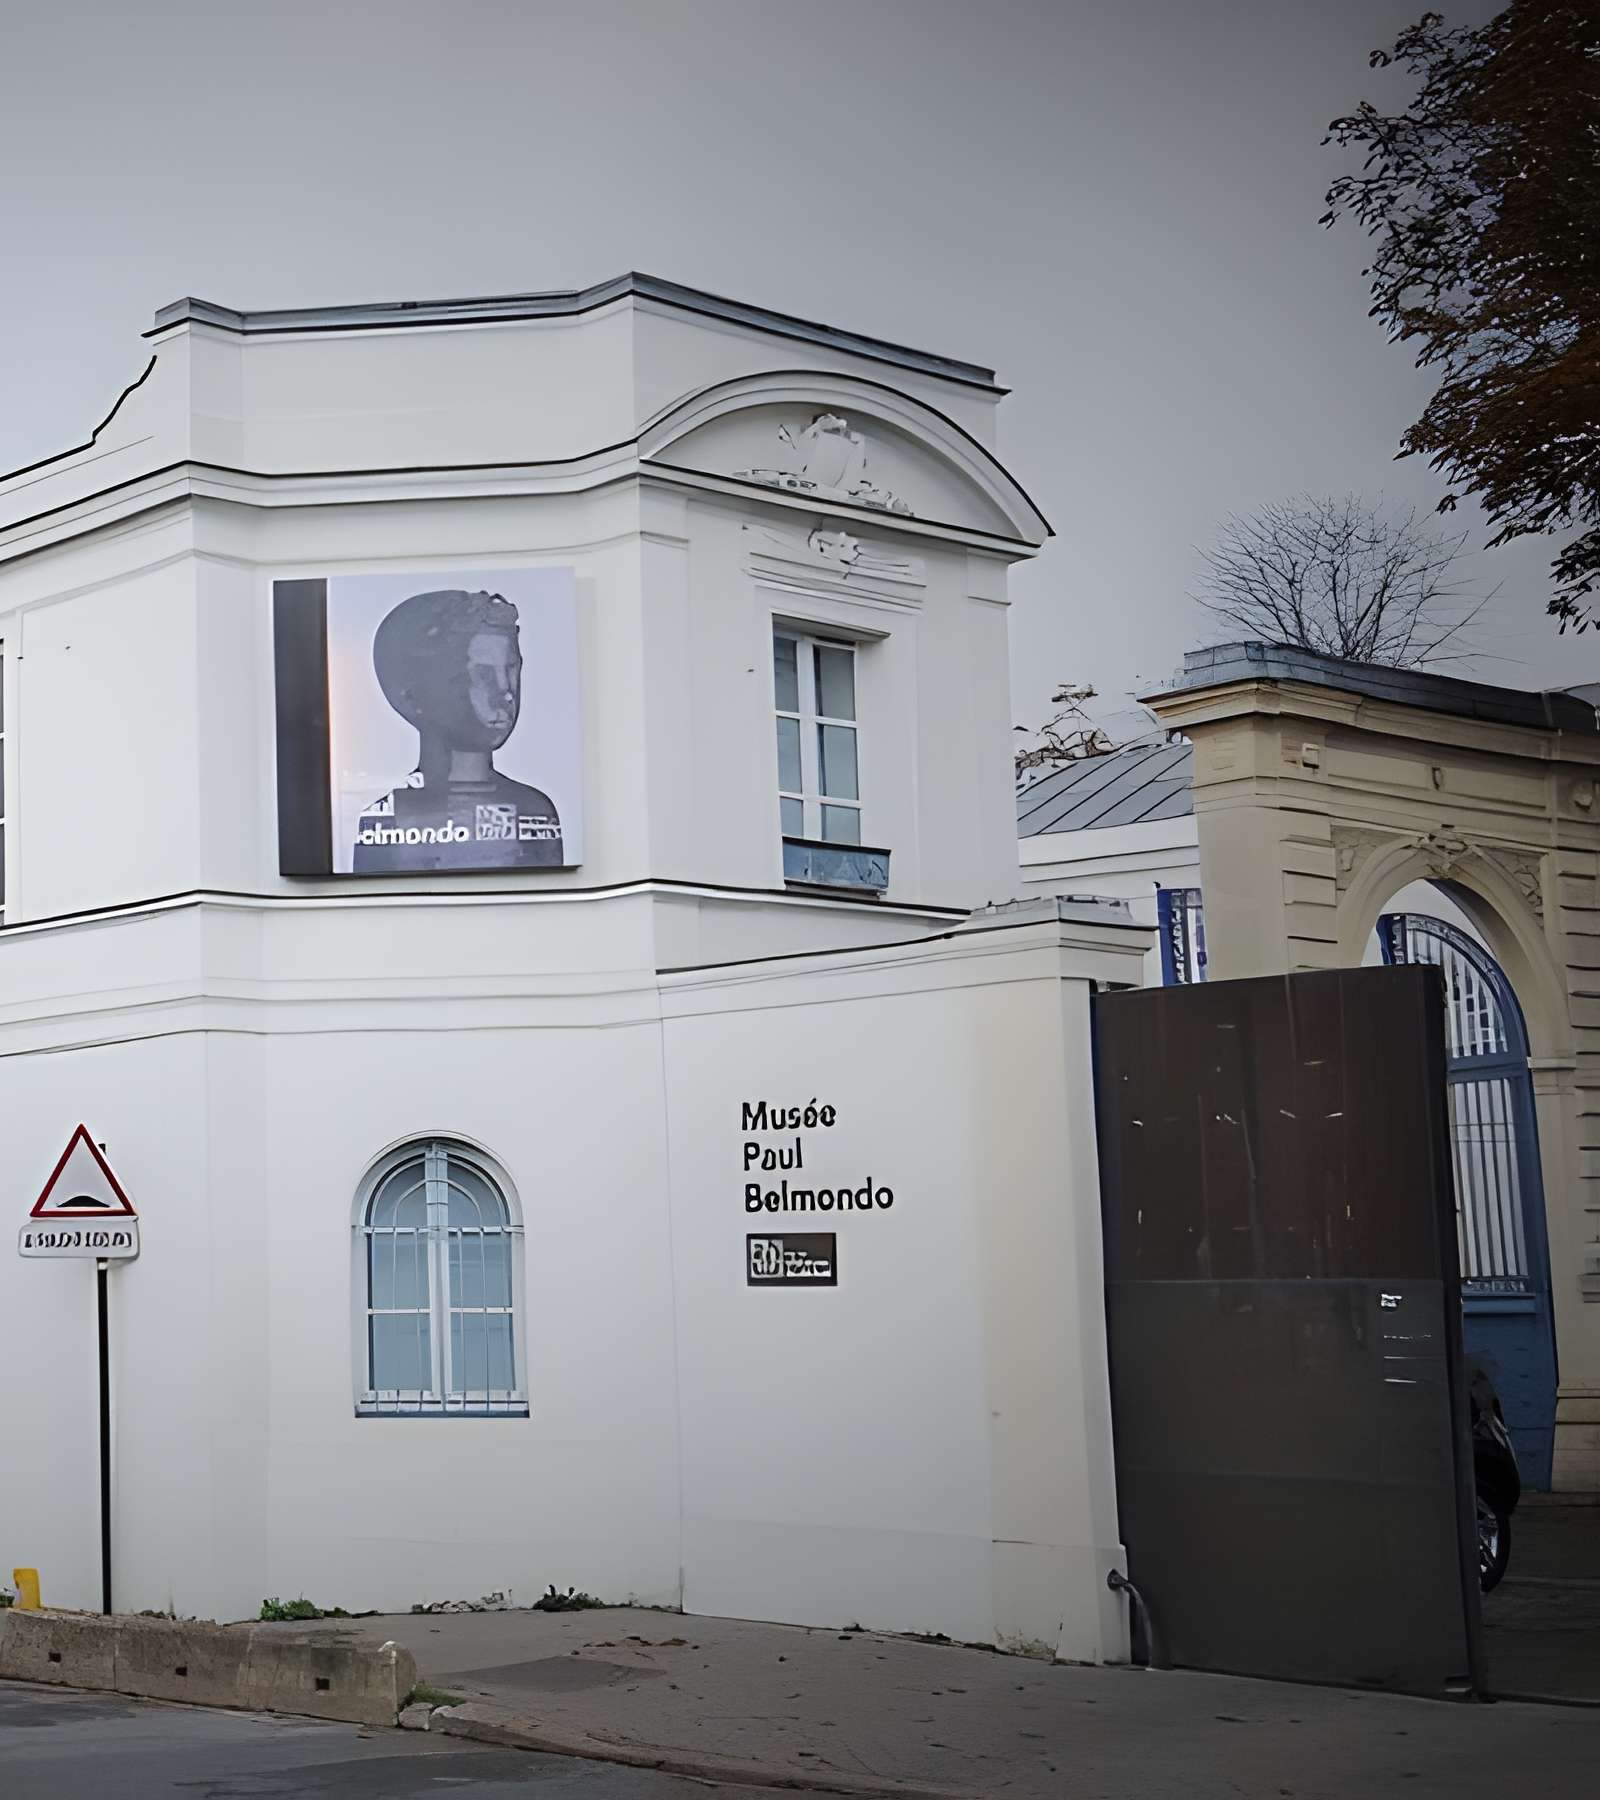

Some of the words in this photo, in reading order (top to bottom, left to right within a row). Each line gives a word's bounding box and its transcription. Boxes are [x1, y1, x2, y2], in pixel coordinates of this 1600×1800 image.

[741, 1097, 837, 1131] Musée
[743, 1136, 803, 1171] Paul
[744, 1176, 894, 1213] Belmondo
